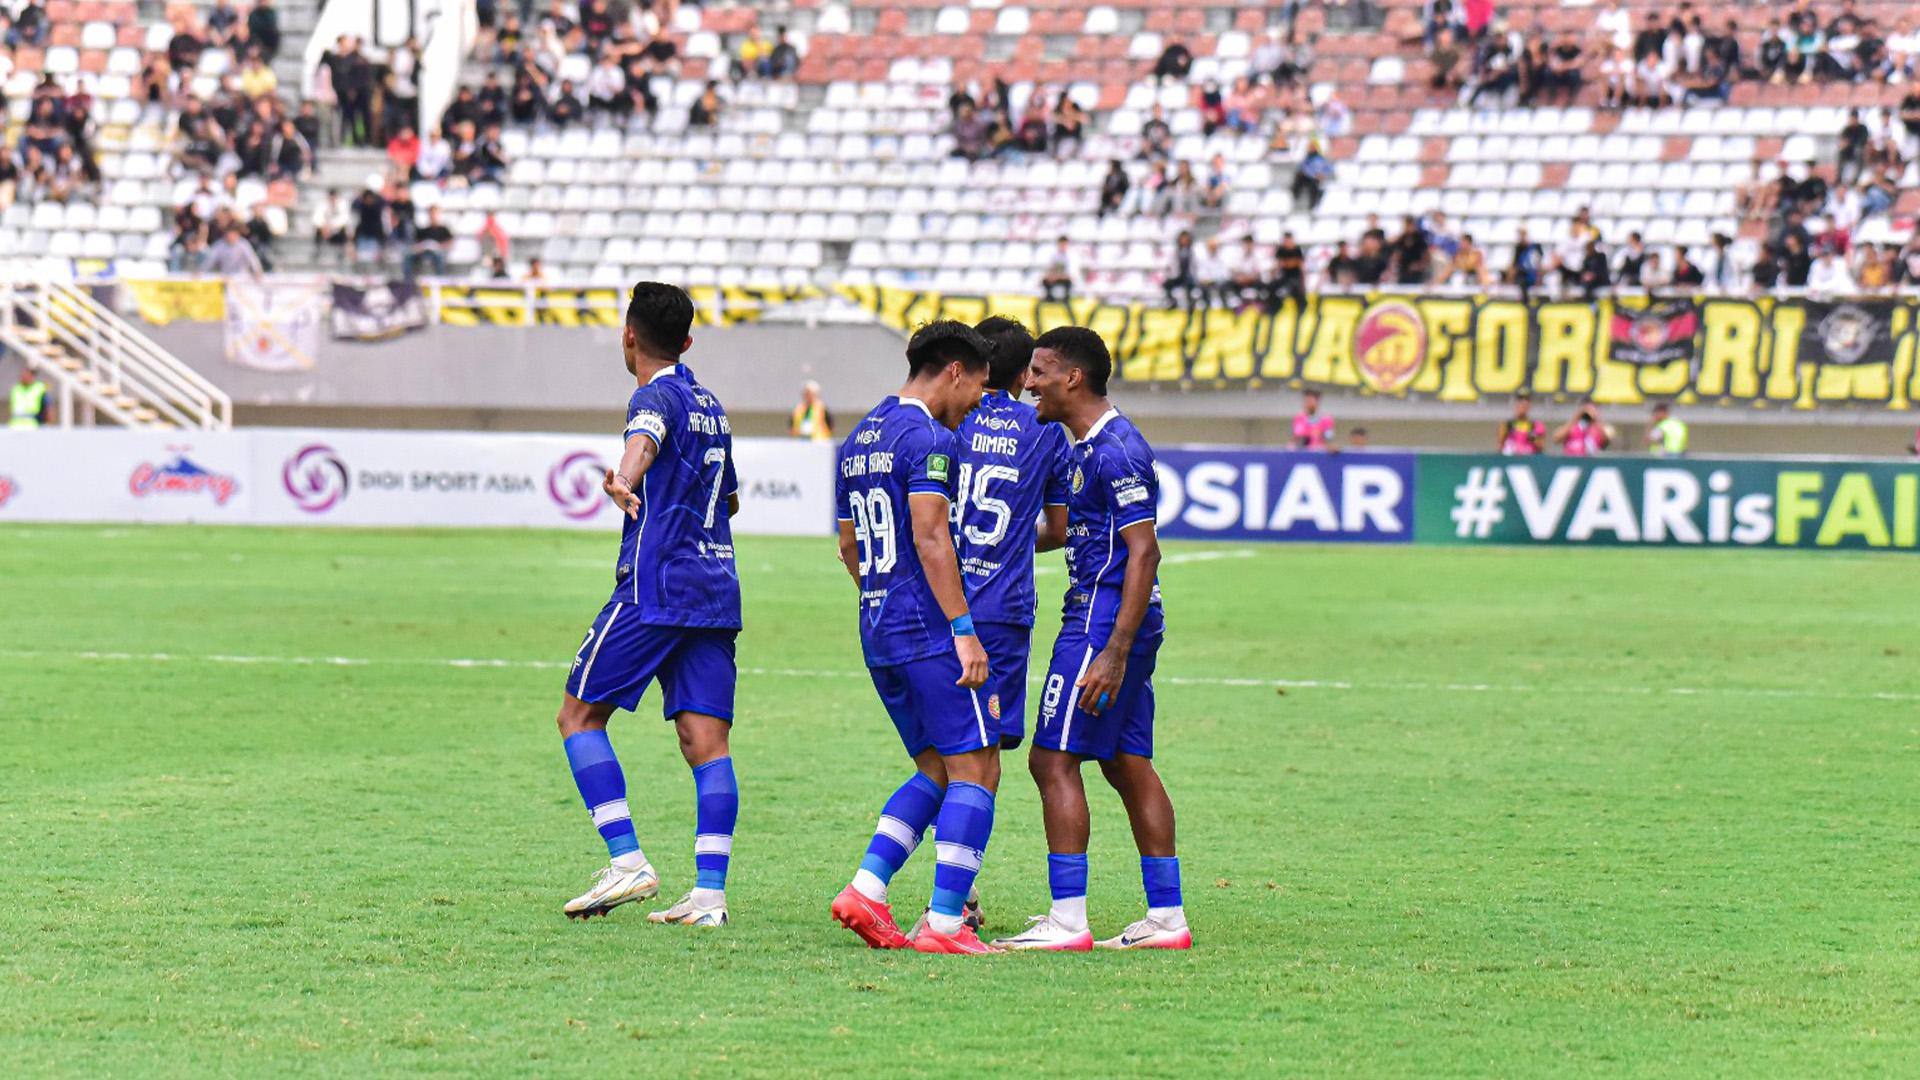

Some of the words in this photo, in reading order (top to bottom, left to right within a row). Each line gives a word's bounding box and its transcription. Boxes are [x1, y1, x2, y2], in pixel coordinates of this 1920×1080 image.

[1415, 300, 1595, 395] FOR
[971, 432, 1018, 456] DIMAS
[974, 413, 1021, 431] MOYA
[358, 470, 404, 490] DIGI
[411, 471, 479, 493] SPORT
[485, 474, 536, 495] ASIA
[703, 447, 726, 529] 7
[957, 462, 1020, 548] 15
[848, 487, 897, 576] 99
[1044, 672, 1065, 709] 8
